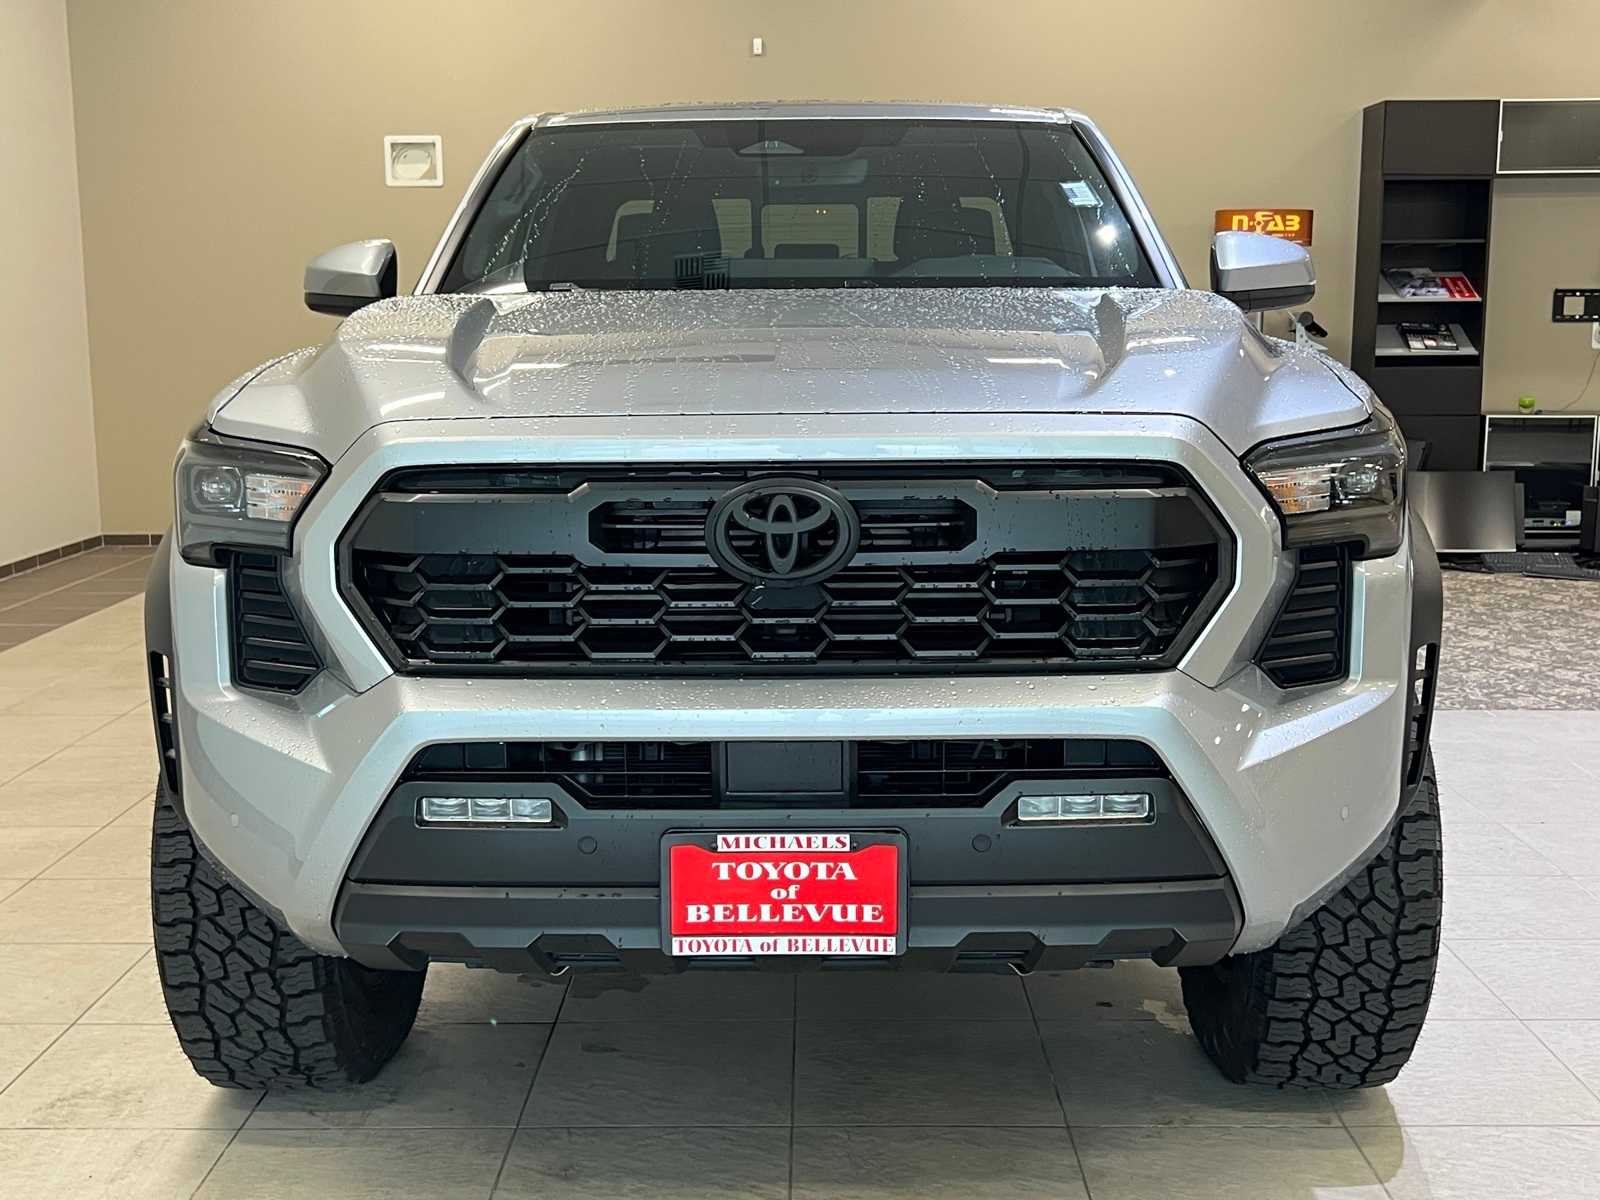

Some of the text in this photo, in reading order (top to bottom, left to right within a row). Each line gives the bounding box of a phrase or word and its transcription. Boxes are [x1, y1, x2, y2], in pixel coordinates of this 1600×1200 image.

[720, 836, 848, 849] MICHAELS
[711, 862, 858, 881] TOYOTA
[770, 885, 800, 900] of
[686, 904, 884, 923] BELLEVUE
[674, 938, 894, 953] TOYOTA of BELLEVUE
